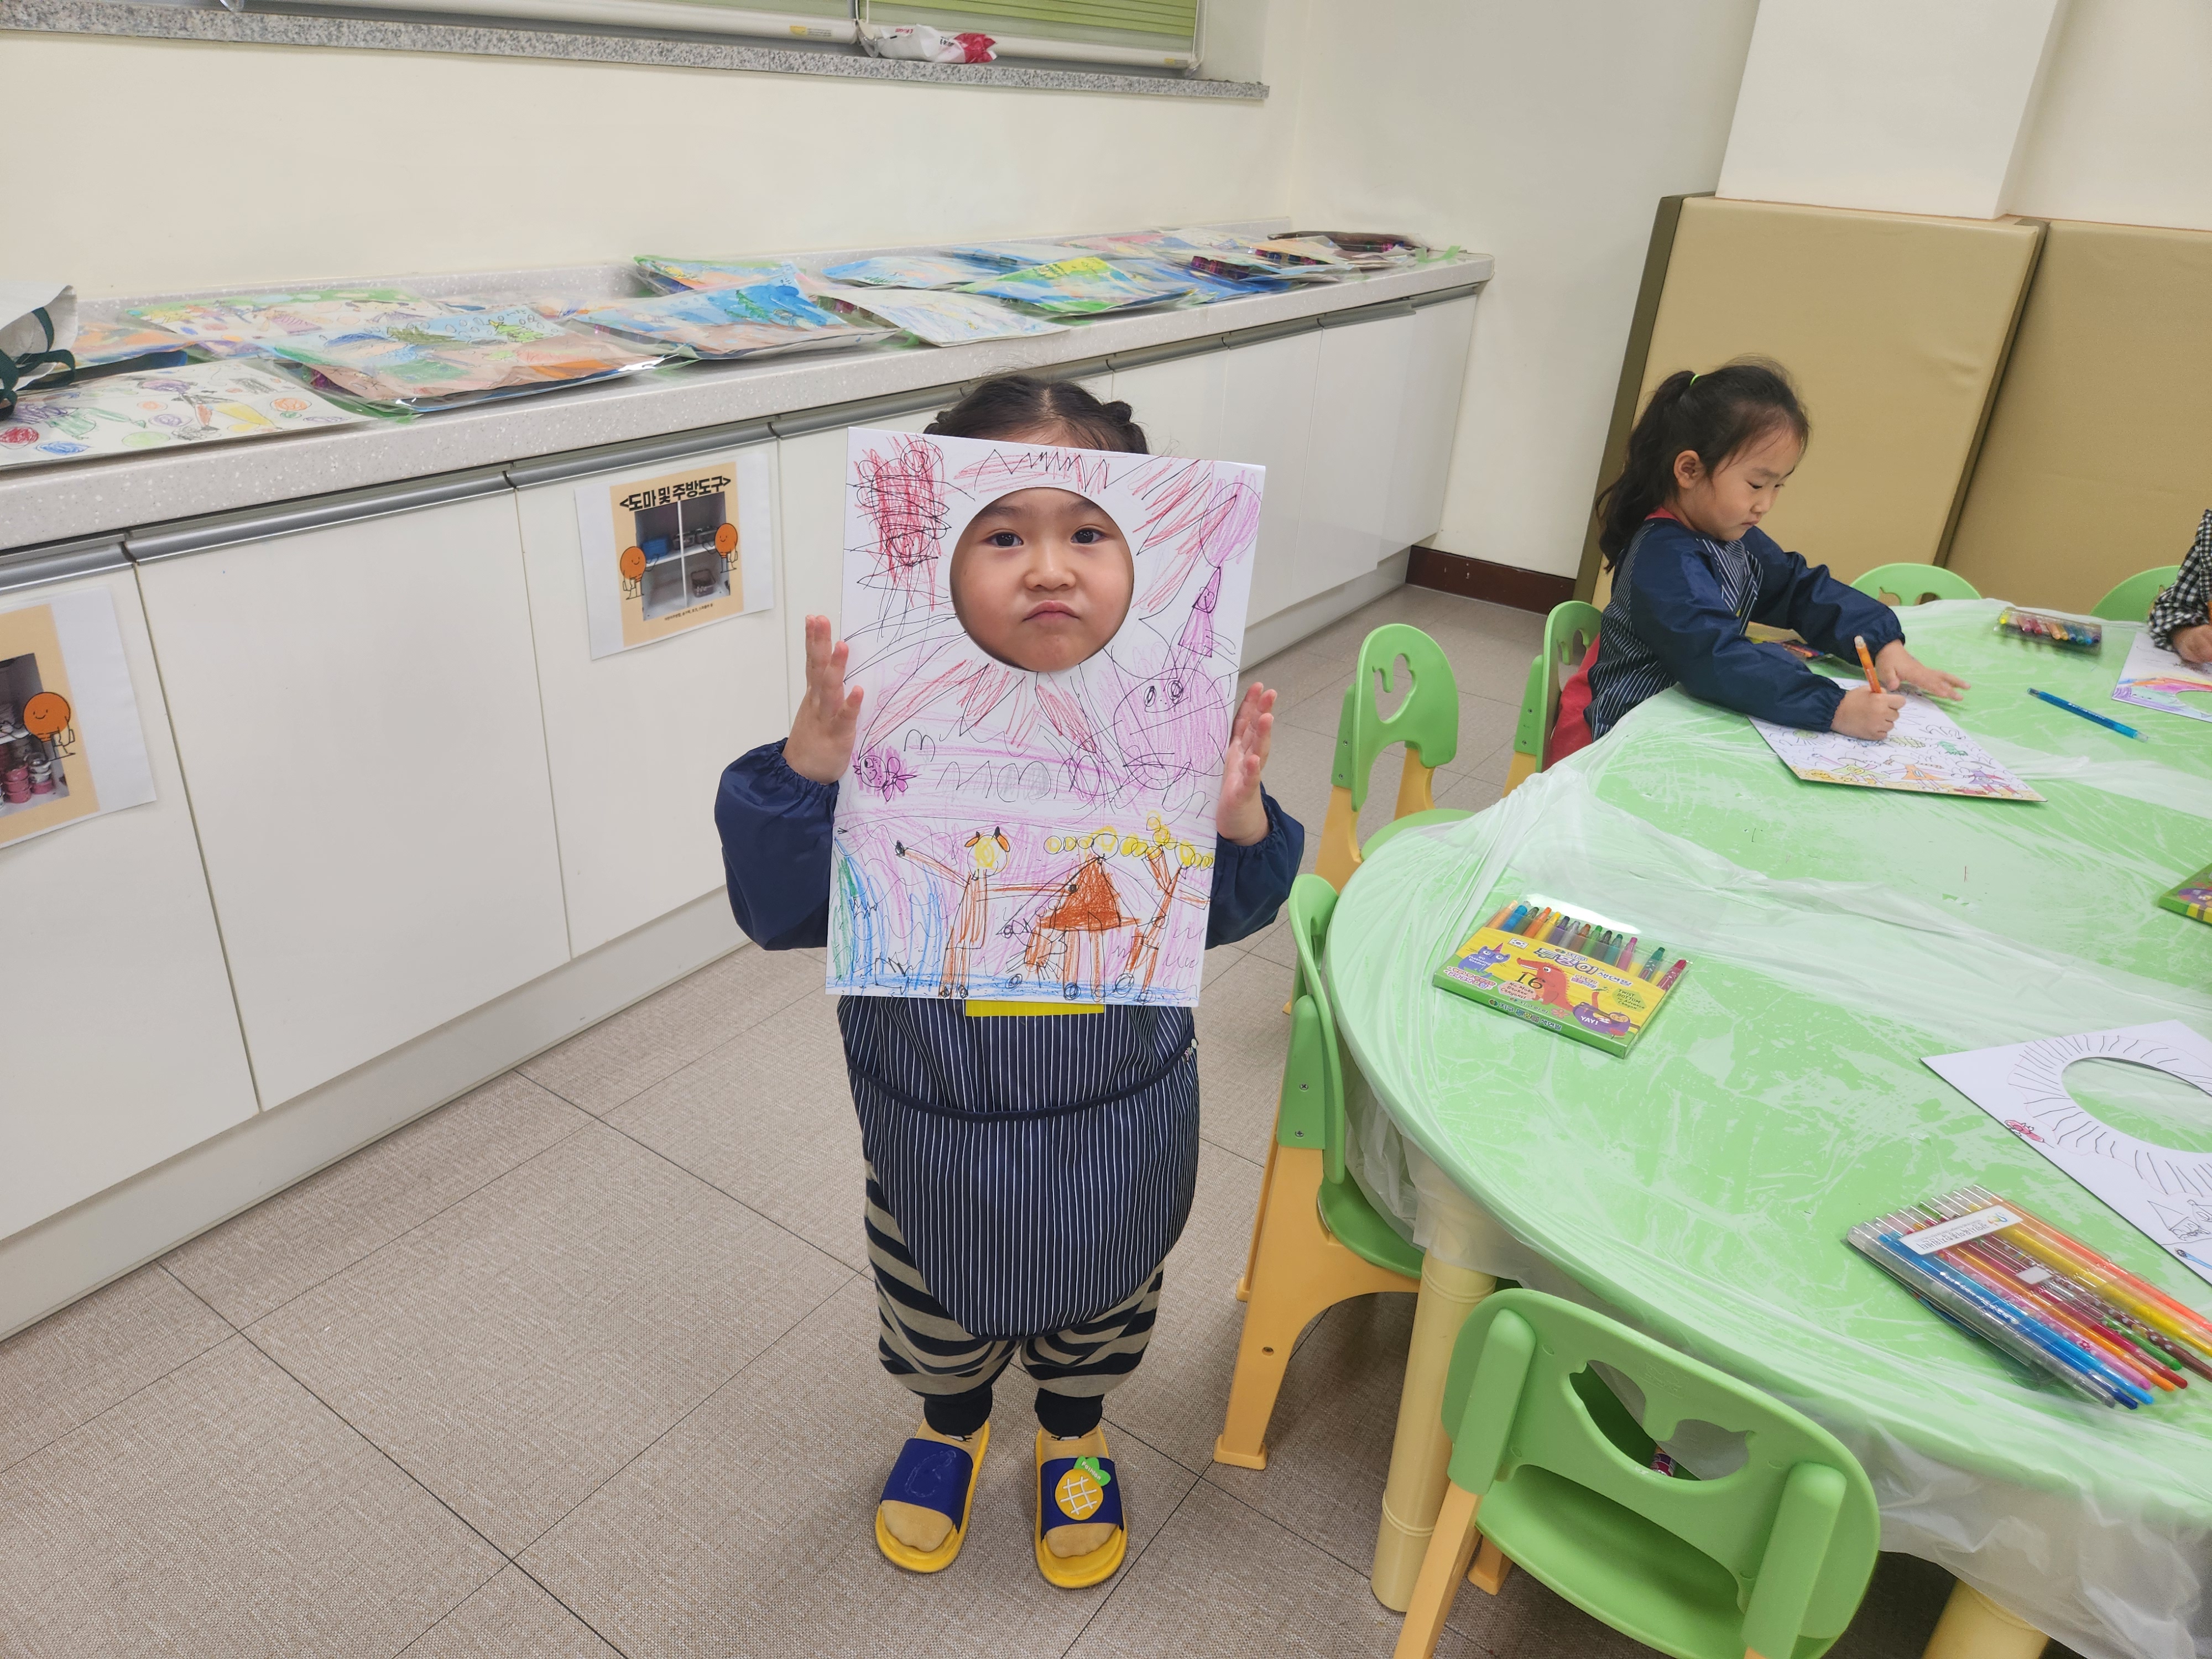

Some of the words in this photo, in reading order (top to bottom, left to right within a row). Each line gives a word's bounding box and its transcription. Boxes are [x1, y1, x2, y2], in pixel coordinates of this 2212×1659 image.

[619, 490, 656, 512] <도마
[658, 486, 671, 505] 및
[672, 476, 731, 500] 주방도구>
[1533, 947, 1599, 975] 투명이
[1514, 971, 1543, 989] 16
[1617, 993, 1641, 1004] BOTTOM
[1618, 989, 1635, 997] TWIST
[1499, 1003, 1514, 1013] 지구
[1541, 1019, 1562, 1031] 색연필
[1580, 1015, 1599, 1025] YAY!
[1081, 1460, 1101, 1480] Fashion
